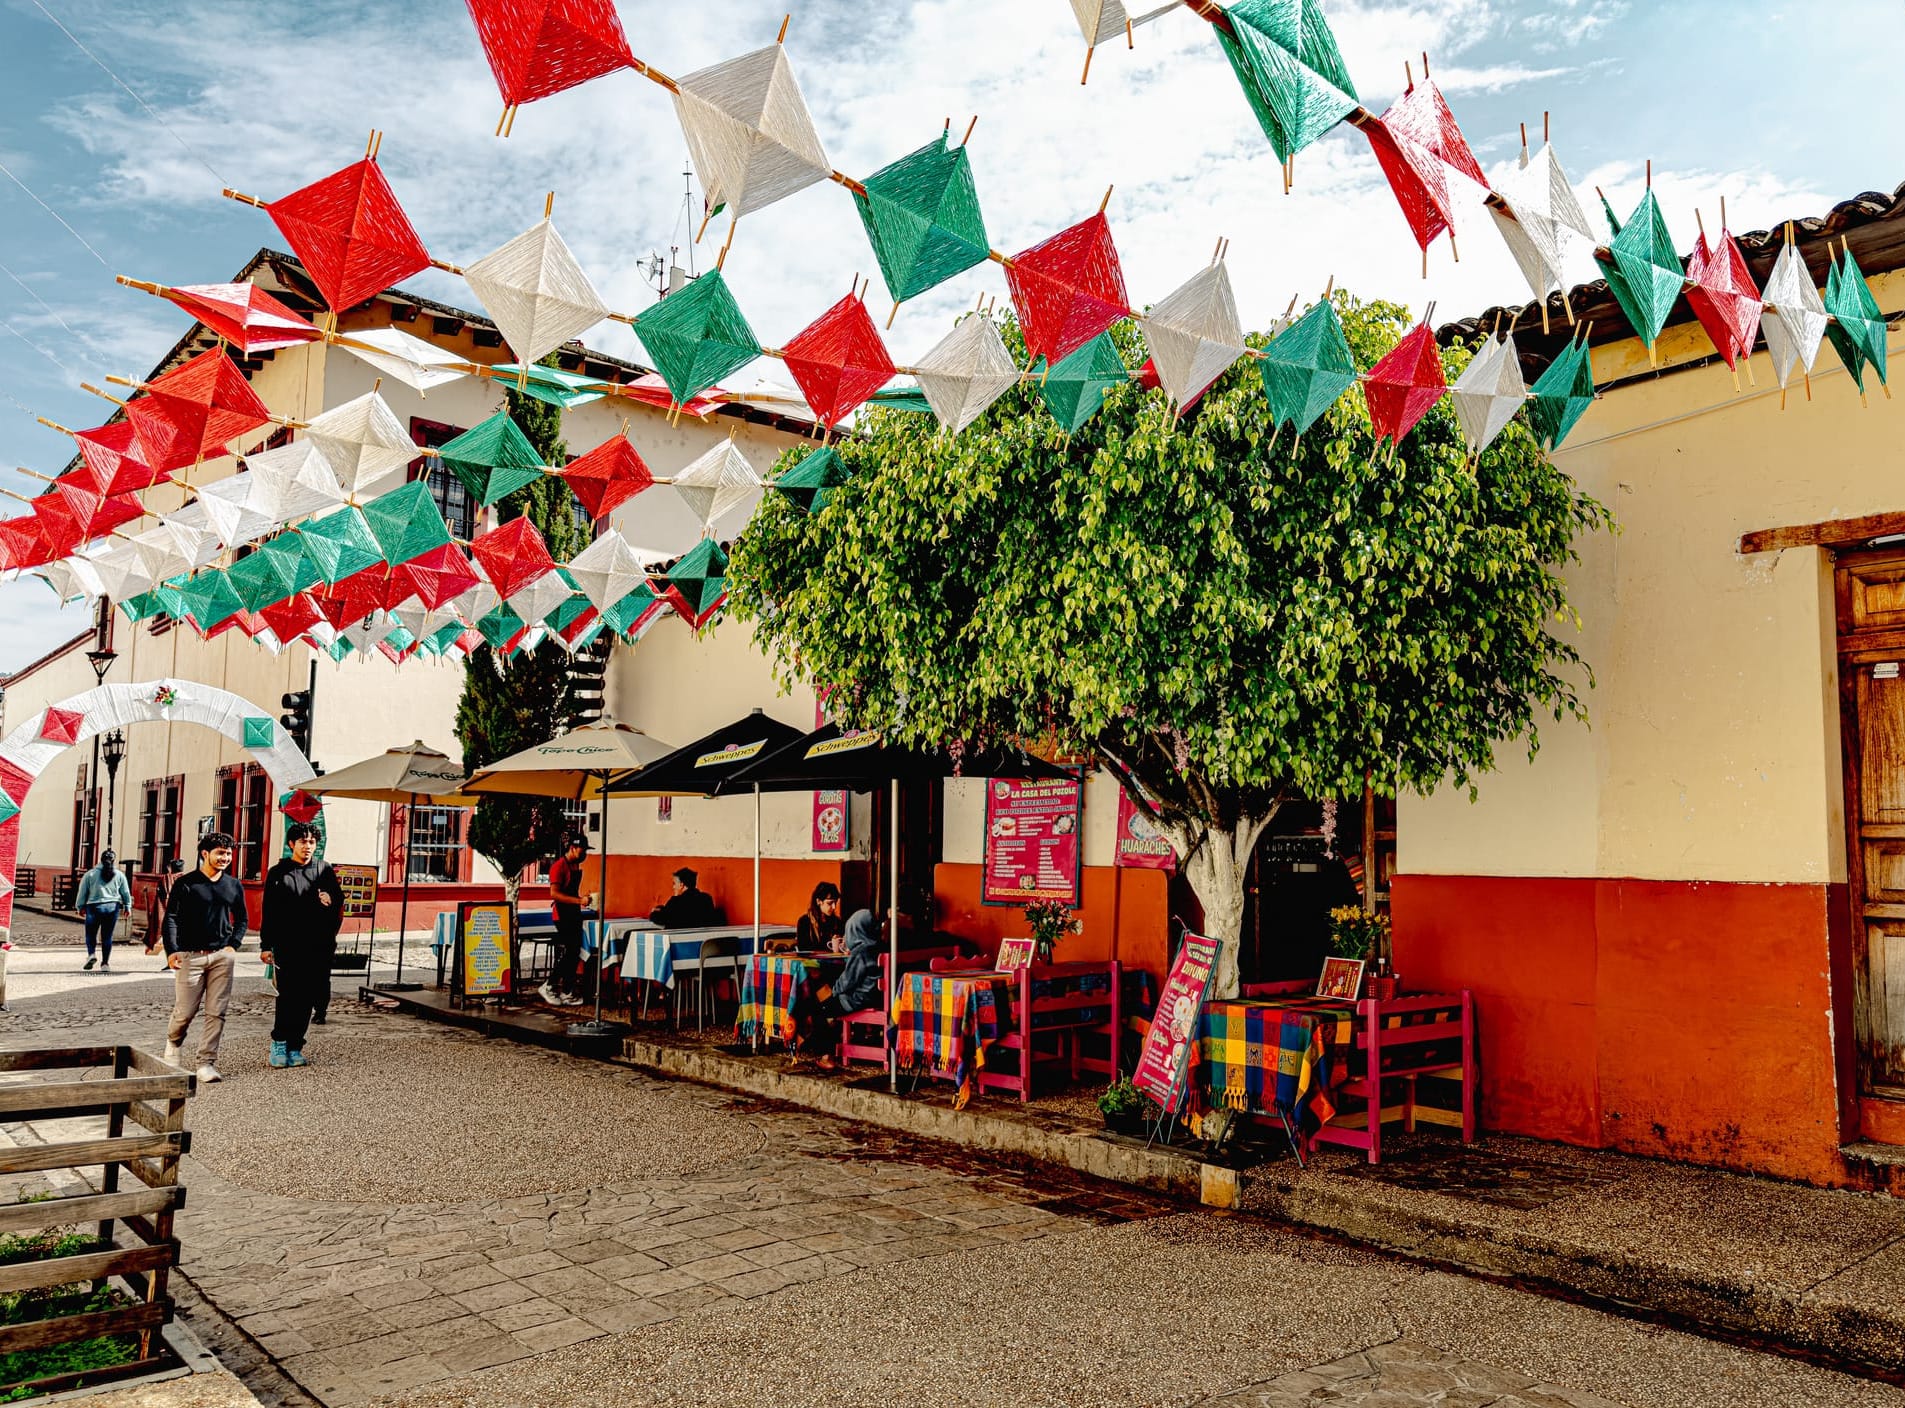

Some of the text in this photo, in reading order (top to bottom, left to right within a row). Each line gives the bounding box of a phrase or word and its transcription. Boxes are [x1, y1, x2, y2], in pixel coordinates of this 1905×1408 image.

[538, 745, 617, 755] Topo Chico
[814, 732, 878, 755] Schweppes
[702, 746, 756, 764] Schweppes
[1011, 787, 1076, 798] LA CASA DEL POZOLE
[820, 831, 839, 844] TACOS
[1121, 840, 1170, 855] HUARACHES
